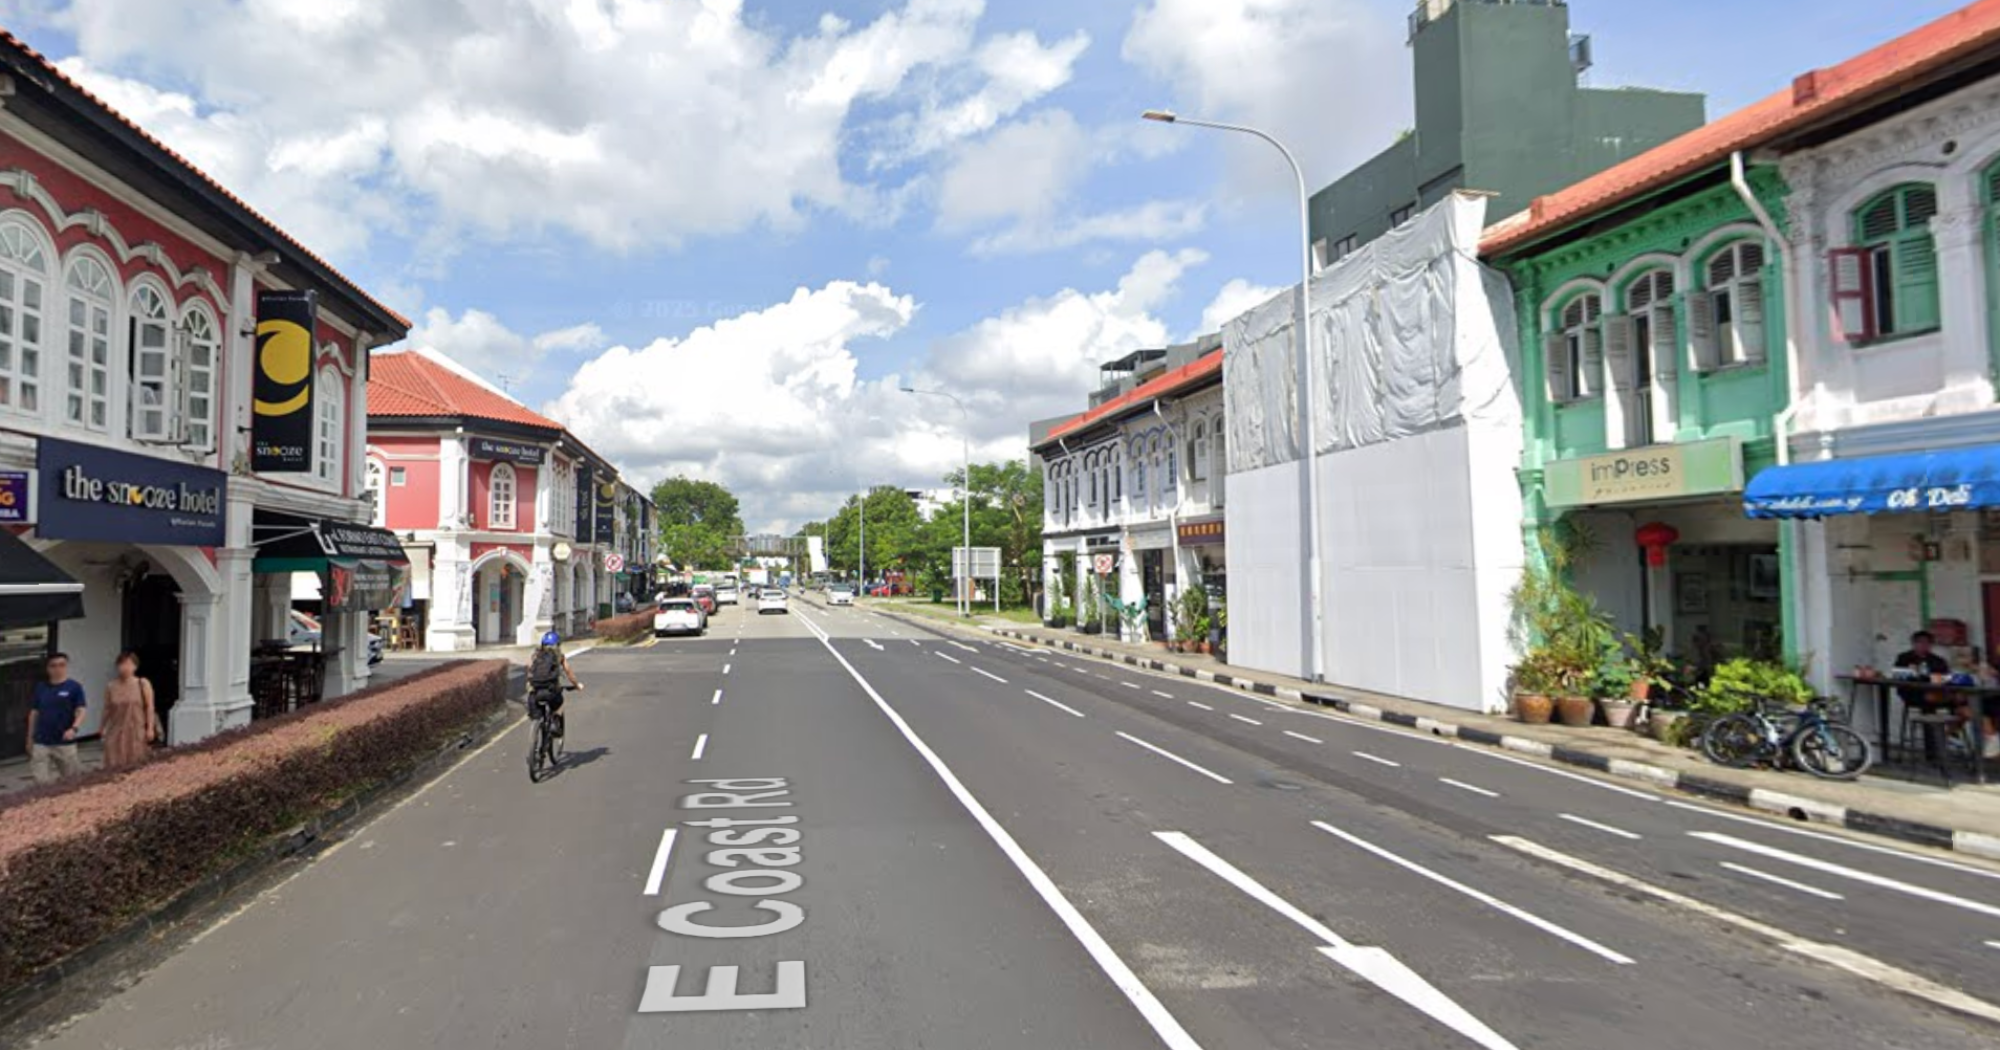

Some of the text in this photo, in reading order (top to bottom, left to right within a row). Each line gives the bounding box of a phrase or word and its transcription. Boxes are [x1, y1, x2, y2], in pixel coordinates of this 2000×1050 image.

[256, 446, 303, 456] snooze
[65, 465, 220, 515] the snooze hotel
